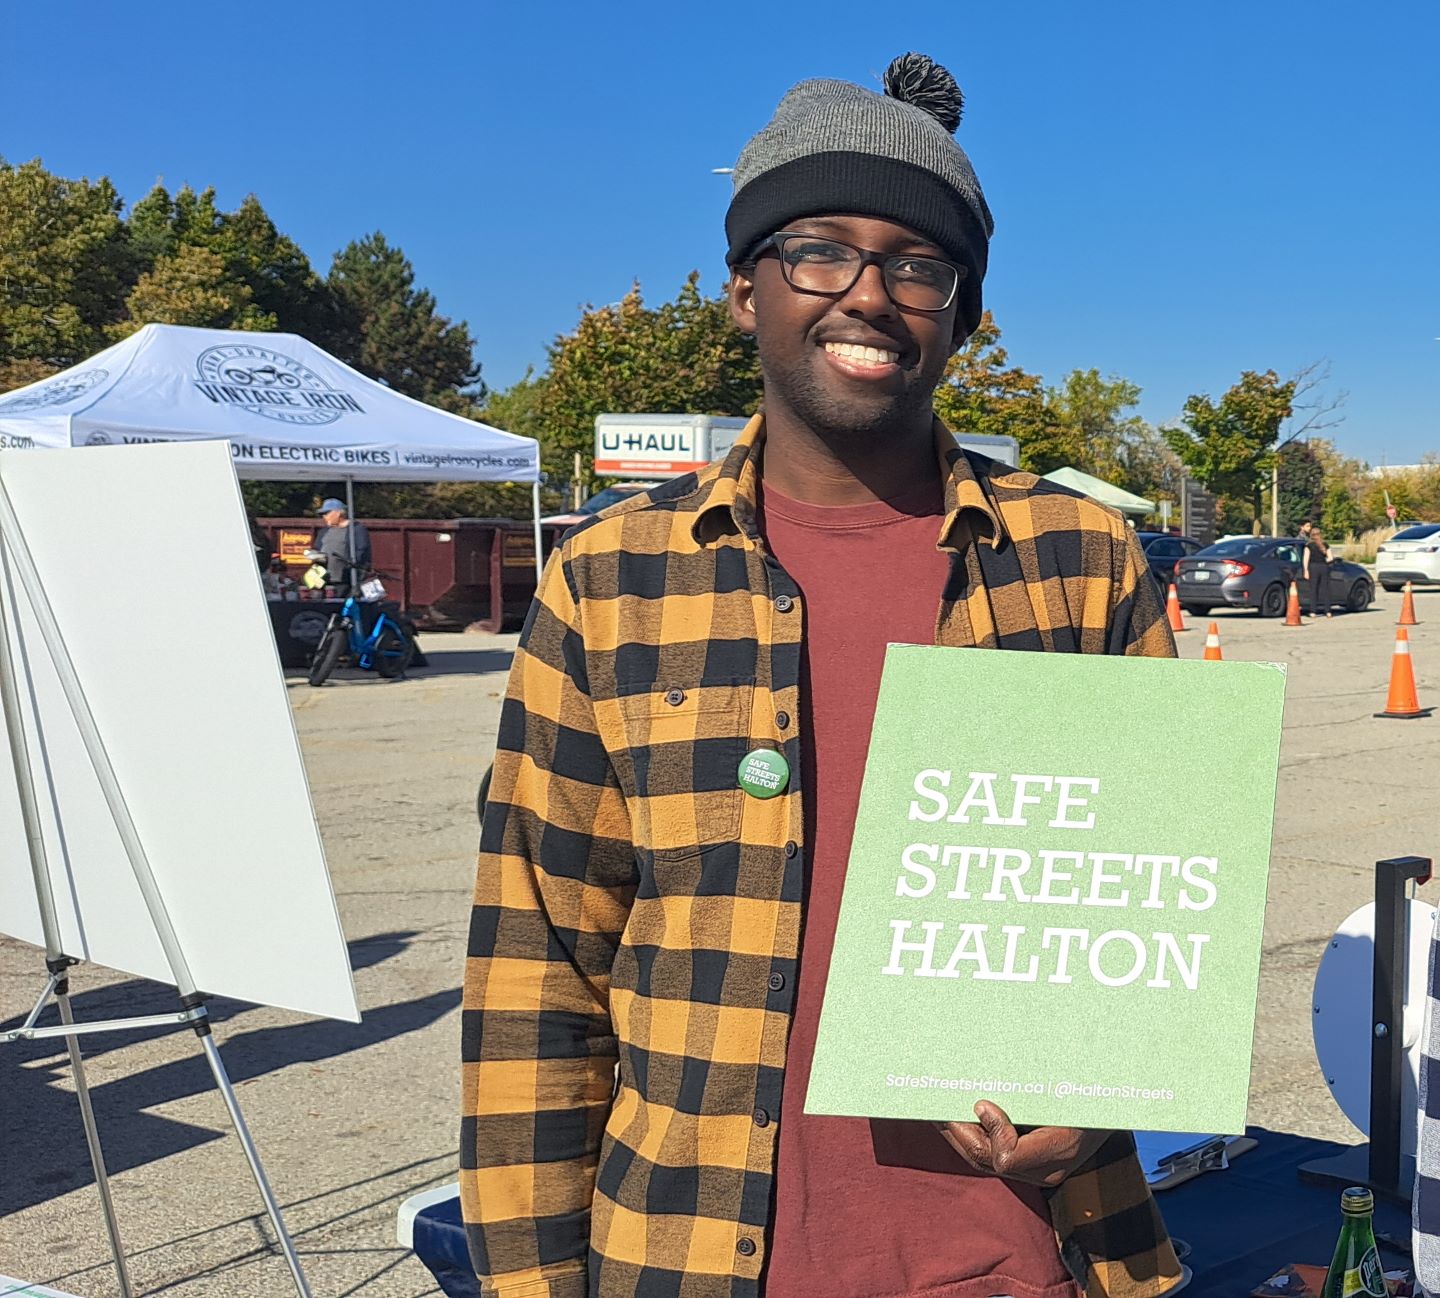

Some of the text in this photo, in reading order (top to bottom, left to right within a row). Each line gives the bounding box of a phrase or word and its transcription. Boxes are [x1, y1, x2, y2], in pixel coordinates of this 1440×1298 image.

[194, 383, 367, 414] VINTAGE IRON
[602, 432, 691, 451] U-HAUL
[231, 444, 254, 458] ON
[259, 446, 343, 462] ELECTRIC
[344, 450, 391, 464] BIKES
[404, 452, 530, 468] vintageironcycles.com
[745, 766, 780, 781] STREETS
[749, 758, 770, 770] SAFE
[743, 773, 779, 790] HALTON
[907, 768, 1099, 829] SAFE
[894, 842, 1218, 912] STREETS
[880, 919, 1211, 990] HALTON
[885, 1073, 1044, 1095] SafeStreetsHalton.ca
[1054, 1081, 1175, 1100] @HaltonStreets
